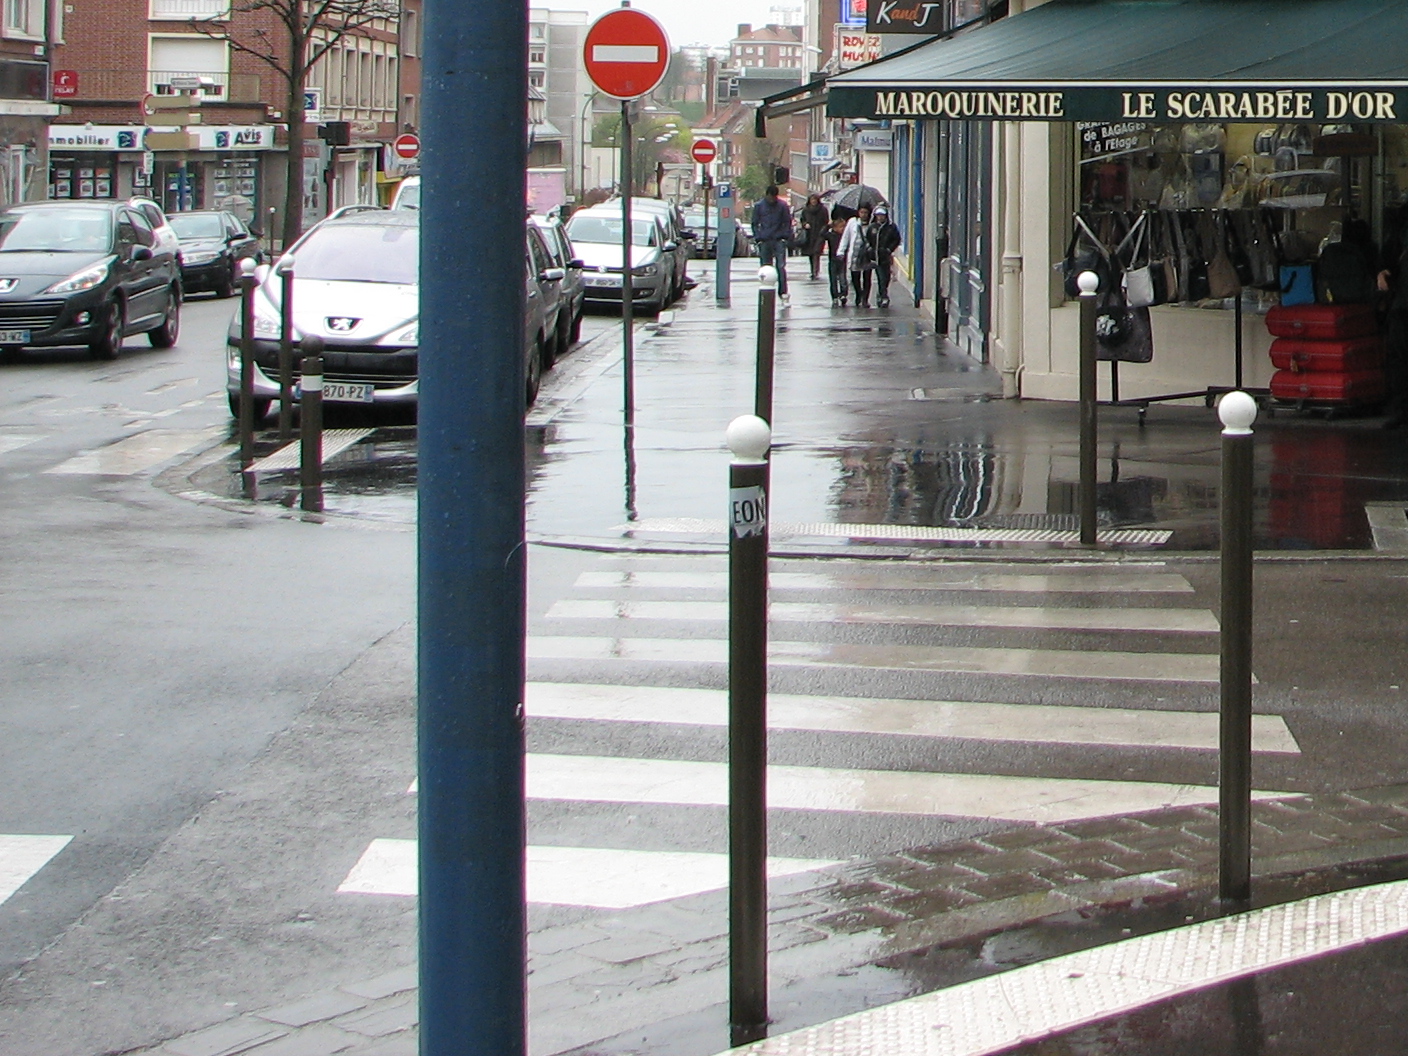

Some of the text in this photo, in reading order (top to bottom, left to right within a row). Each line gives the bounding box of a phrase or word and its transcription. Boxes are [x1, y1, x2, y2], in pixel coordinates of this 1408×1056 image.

[875, 91, 1064, 119] MAROQUINERIE
[1122, 91, 1156, 118] LE
[1326, 91, 1396, 119] D'OR
